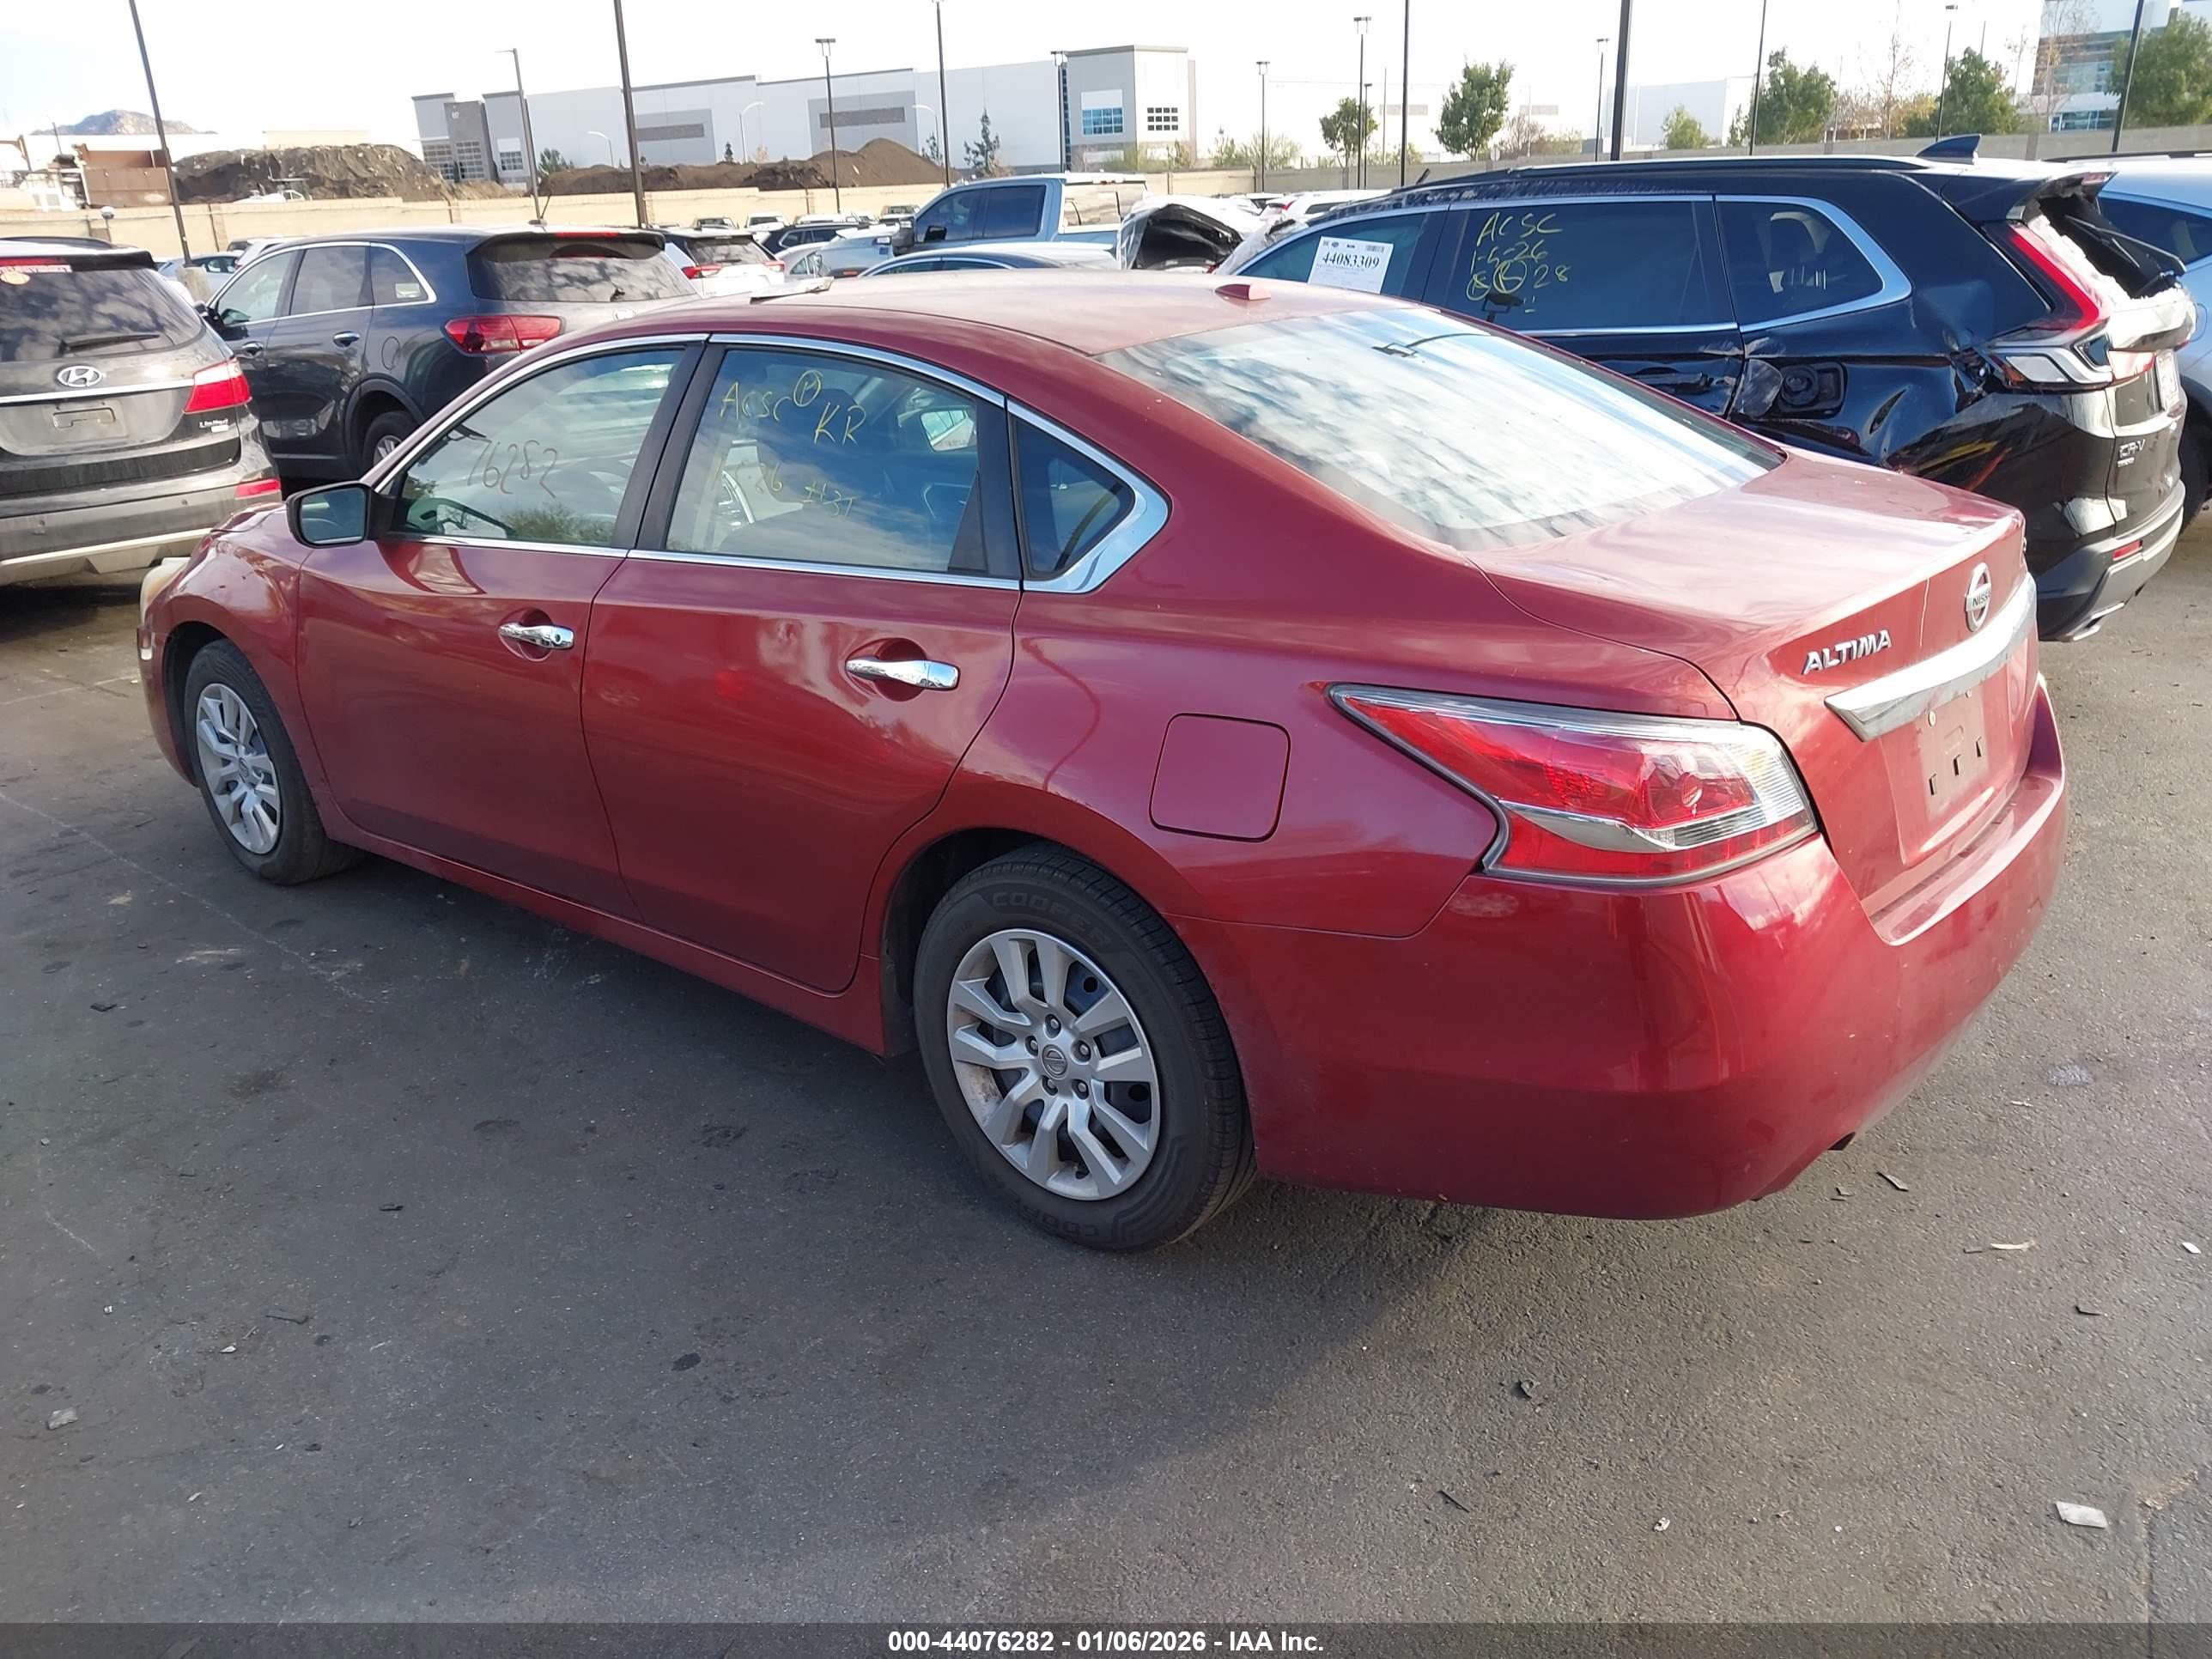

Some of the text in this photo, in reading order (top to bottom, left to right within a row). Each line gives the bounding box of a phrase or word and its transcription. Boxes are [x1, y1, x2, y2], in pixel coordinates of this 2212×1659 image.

[1322, 252, 1380, 269] 44083309
[466, 436, 558, 499] 76282
[1801, 629, 1893, 676] ALTIMA
